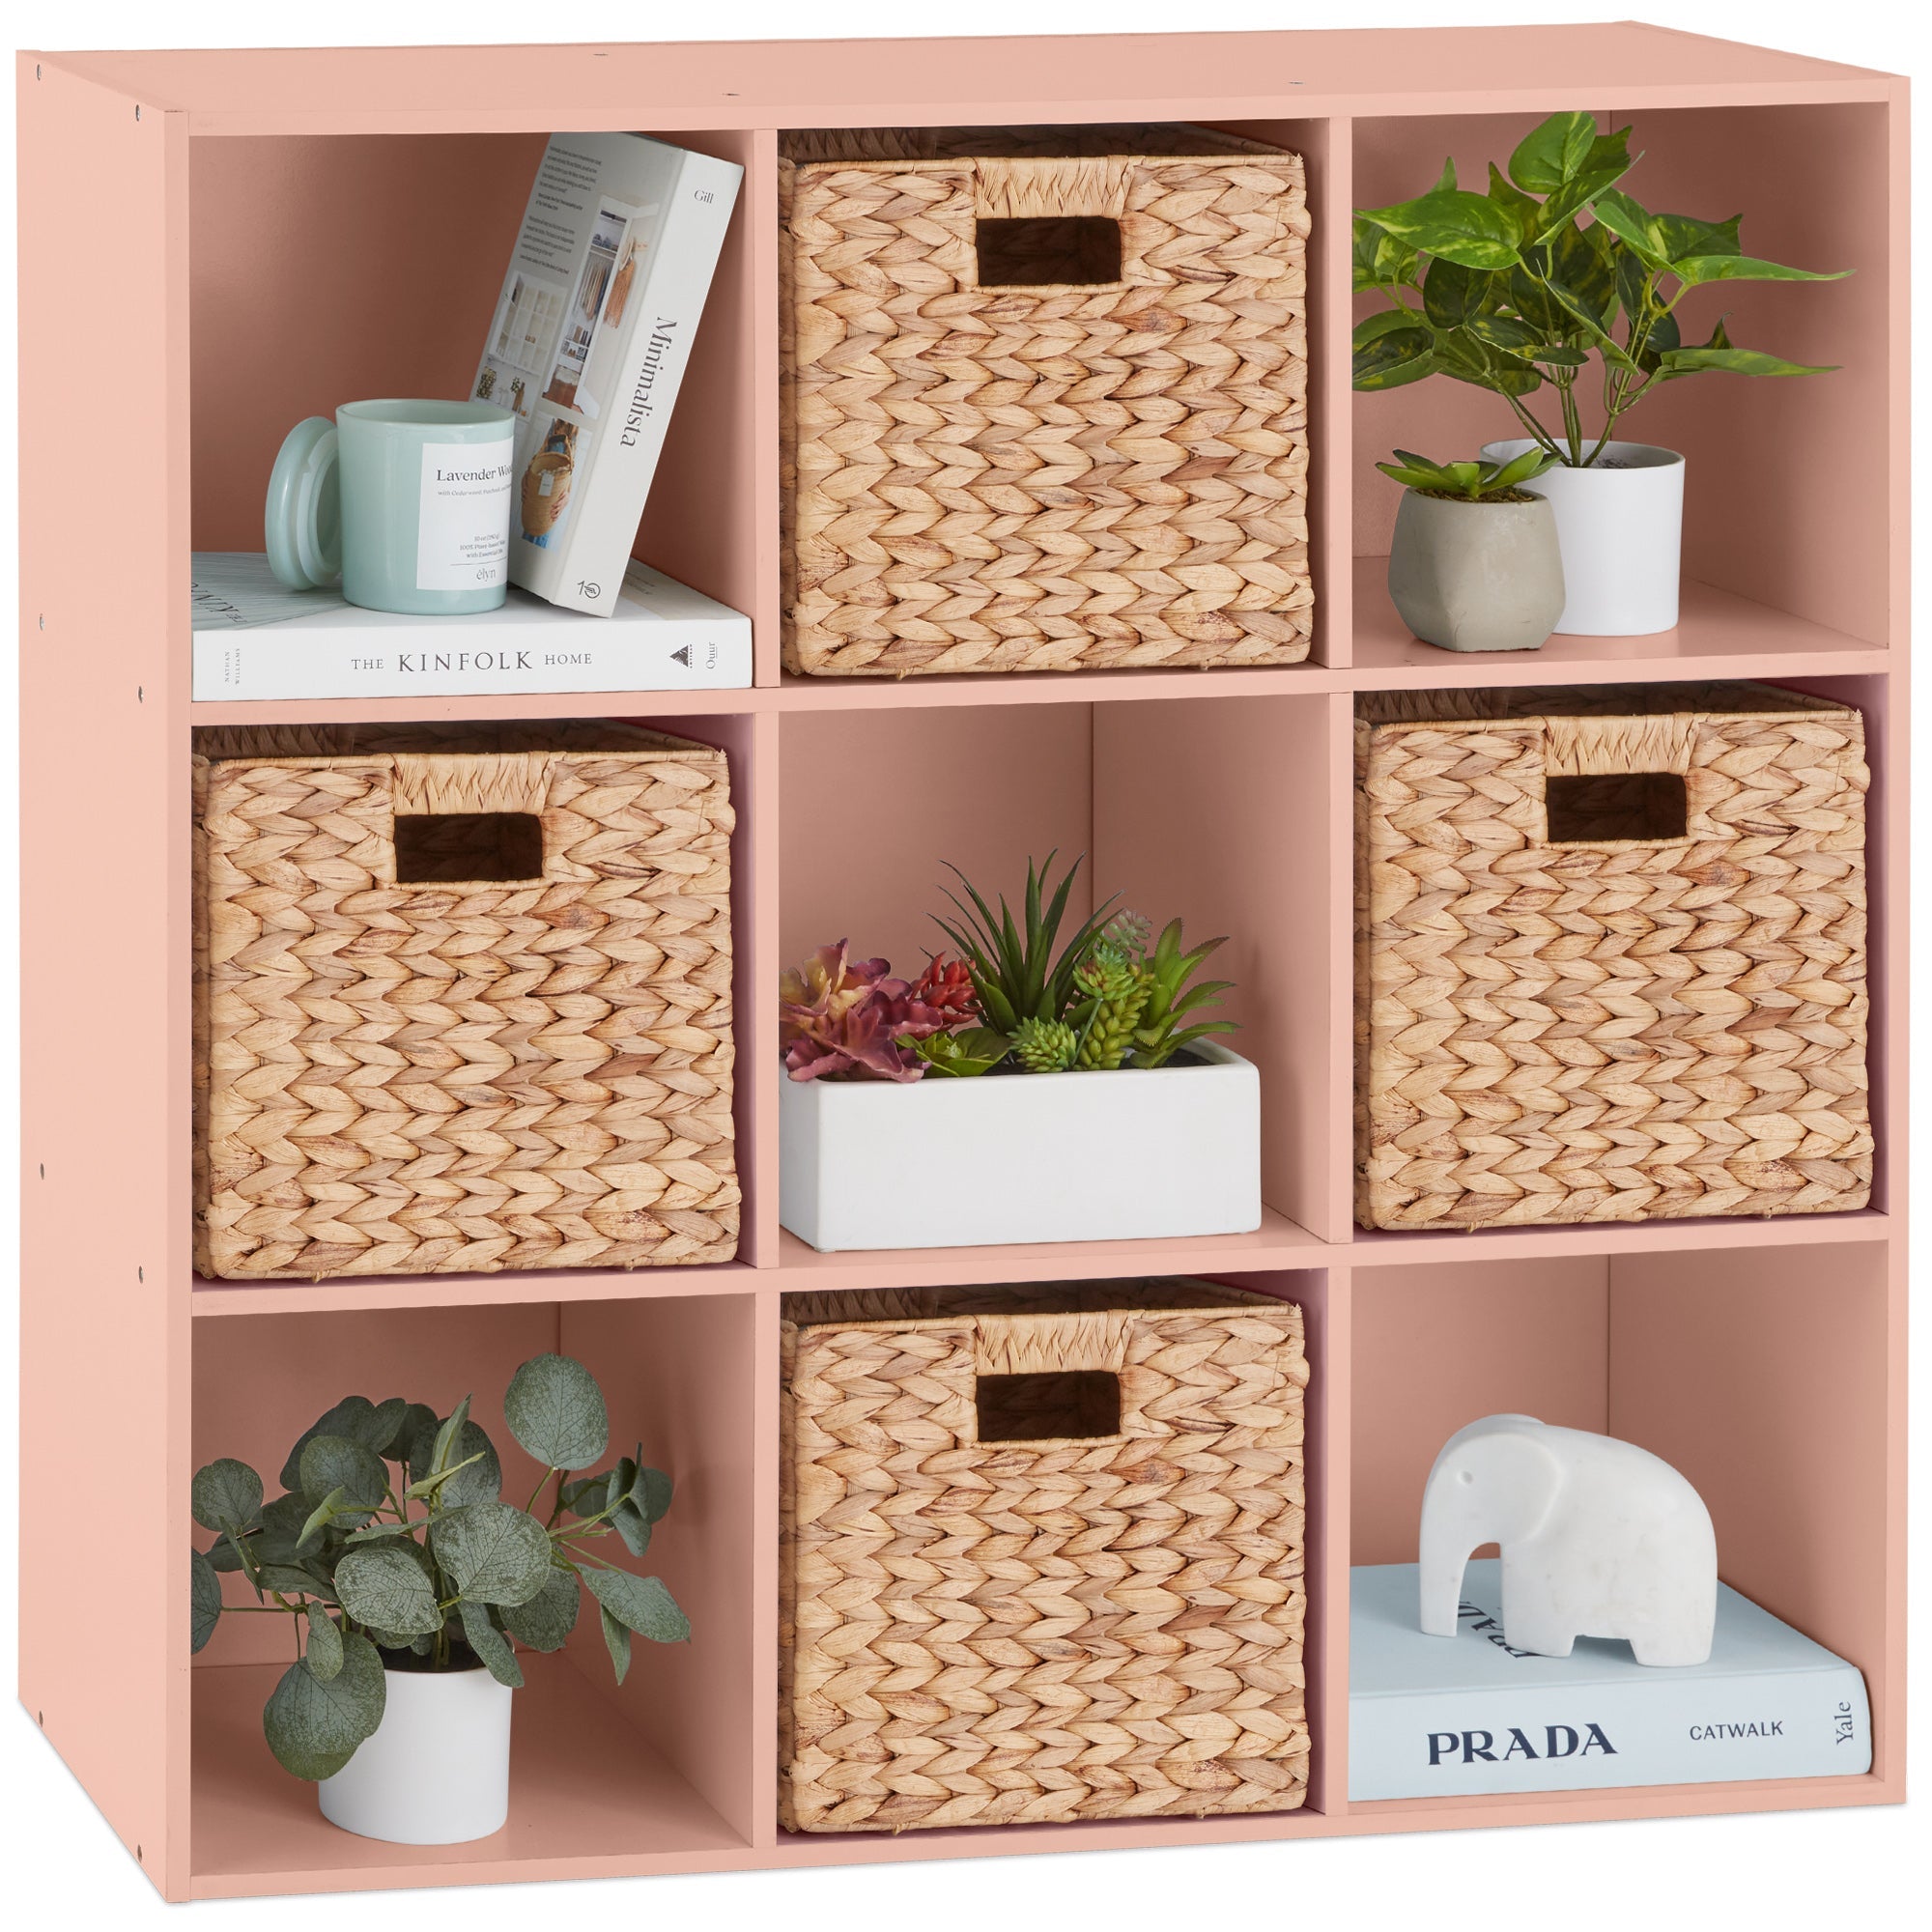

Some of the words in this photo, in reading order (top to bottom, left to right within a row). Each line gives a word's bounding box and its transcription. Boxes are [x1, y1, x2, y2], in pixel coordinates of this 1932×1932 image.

[694, 189, 715, 204] Gill
[620, 316, 678, 448] Minimalista
[437, 469, 497, 482] Lavender
[351, 658, 384, 670] THE
[398, 652, 533, 672] KINFOLK
[544, 653, 592, 666] HOME
[1835, 1701, 1852, 1746] Yale
[1427, 1722, 1618, 1766] PRADA
[1689, 1720, 1784, 1742] CATWALK
